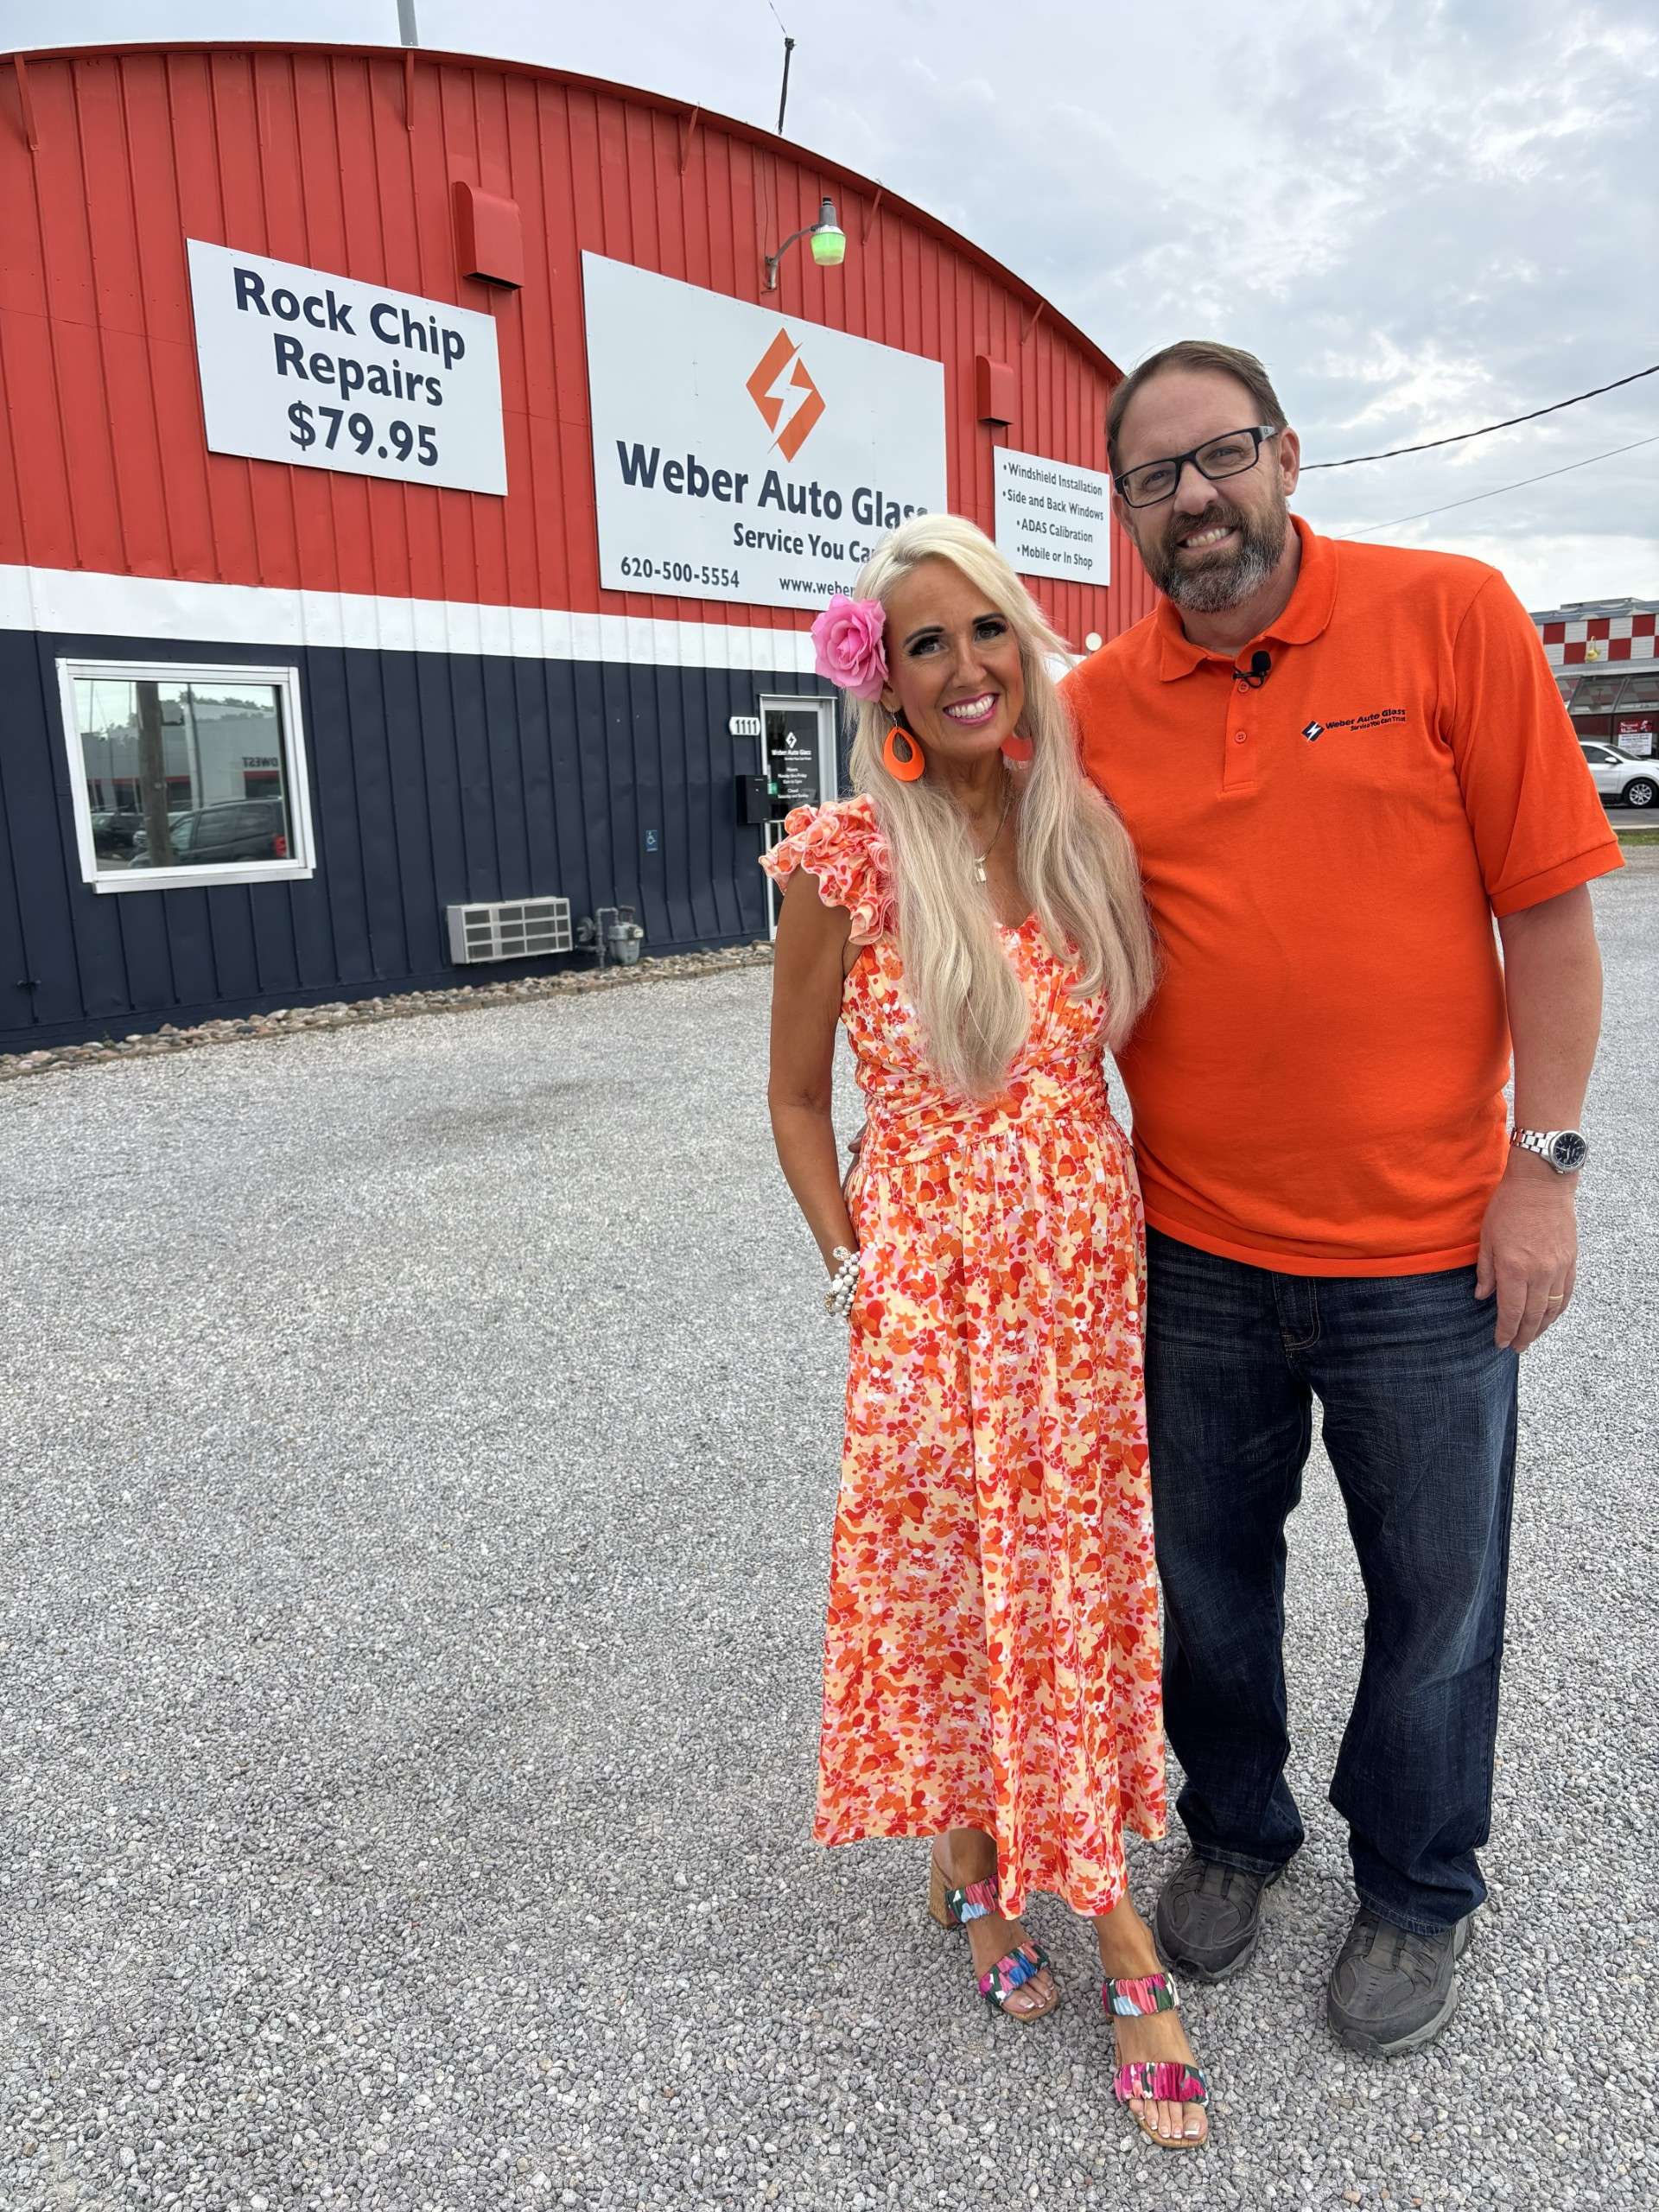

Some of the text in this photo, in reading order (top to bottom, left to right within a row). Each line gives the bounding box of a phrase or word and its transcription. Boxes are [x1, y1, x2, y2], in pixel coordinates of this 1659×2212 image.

[233, 267, 465, 370] Rock Chip
[274, 333, 442, 406] Repairs
[288, 400, 439, 467] $79.95
[616, 440, 749, 504] Weber
[757, 469, 842, 520] Auto
[1008, 462, 1103, 496] Windshield Installation
[1007, 489, 1103, 521] Side and Back Windows
[734, 522, 875, 563] Service You Ca
[1021, 518, 1093, 543] ADAS Calibration
[620, 556, 740, 588] 620-500-5554
[1021, 544, 1093, 570] Mobile or In Shop
[735, 719, 757, 734] 1111
[1325, 719, 1355, 729] Weber
[1357, 713, 1380, 723] Auto
